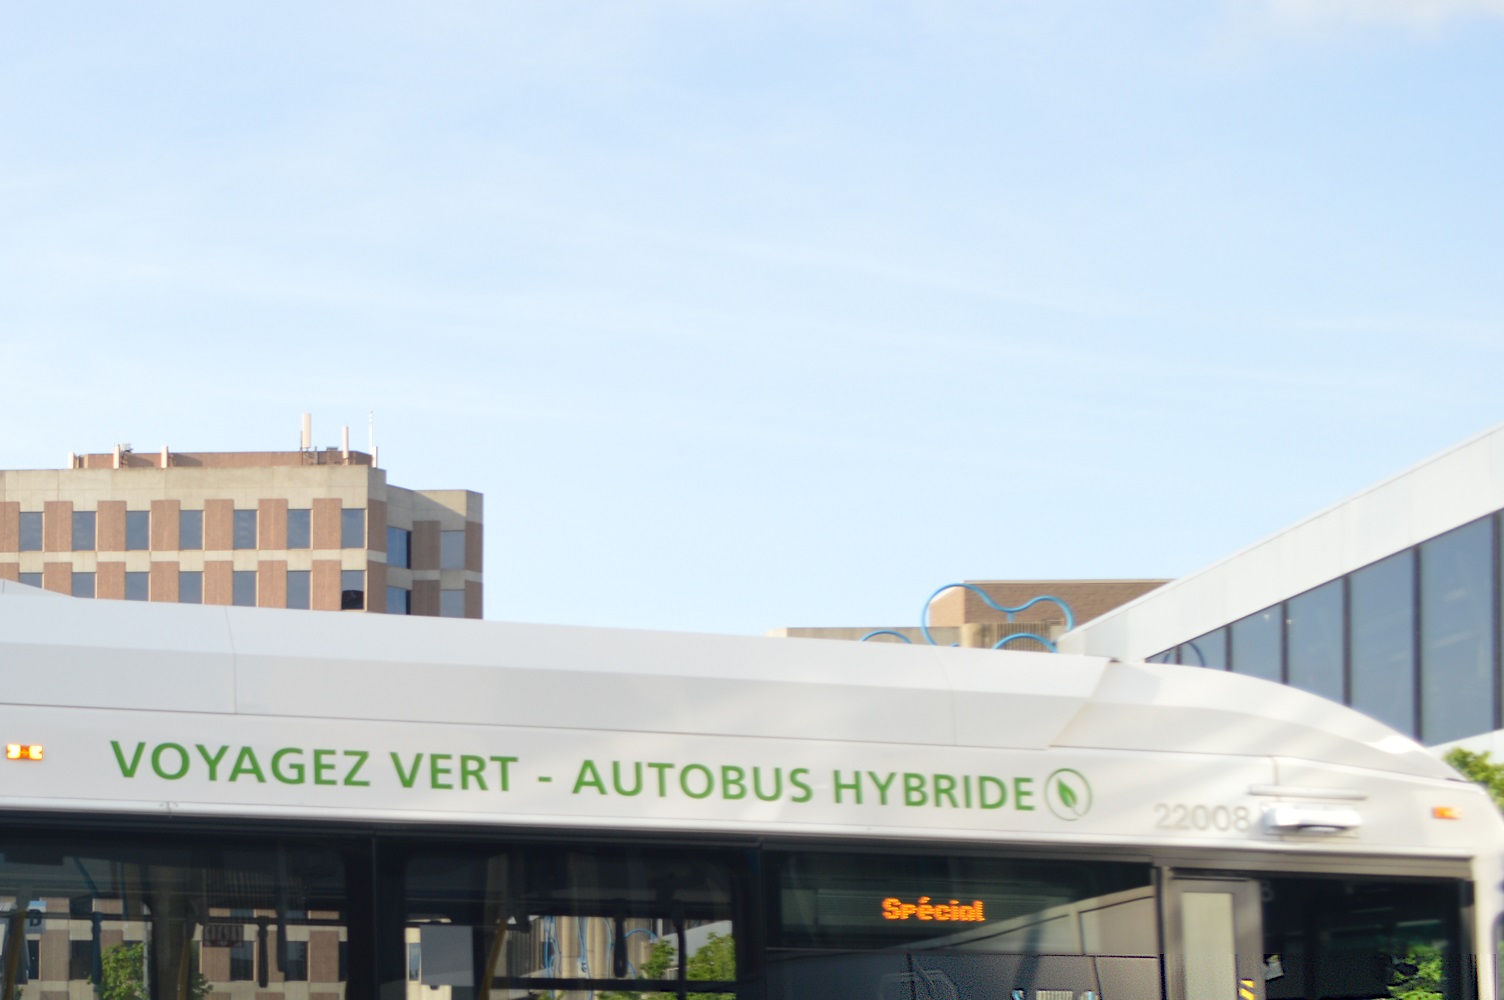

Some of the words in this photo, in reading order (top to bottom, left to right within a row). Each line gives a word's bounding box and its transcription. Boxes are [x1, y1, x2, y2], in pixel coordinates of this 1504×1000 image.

[109, 738, 370, 789] VOYAGEZ
[388, 751, 519, 793] VERT
[537, 774, 553, 784] -
[570, 758, 815, 805] AUTOBUS
[831, 768, 1036, 812] HYBRIDE
[1154, 802, 1251, 833] 22008
[881, 895, 986, 922] Spécial
